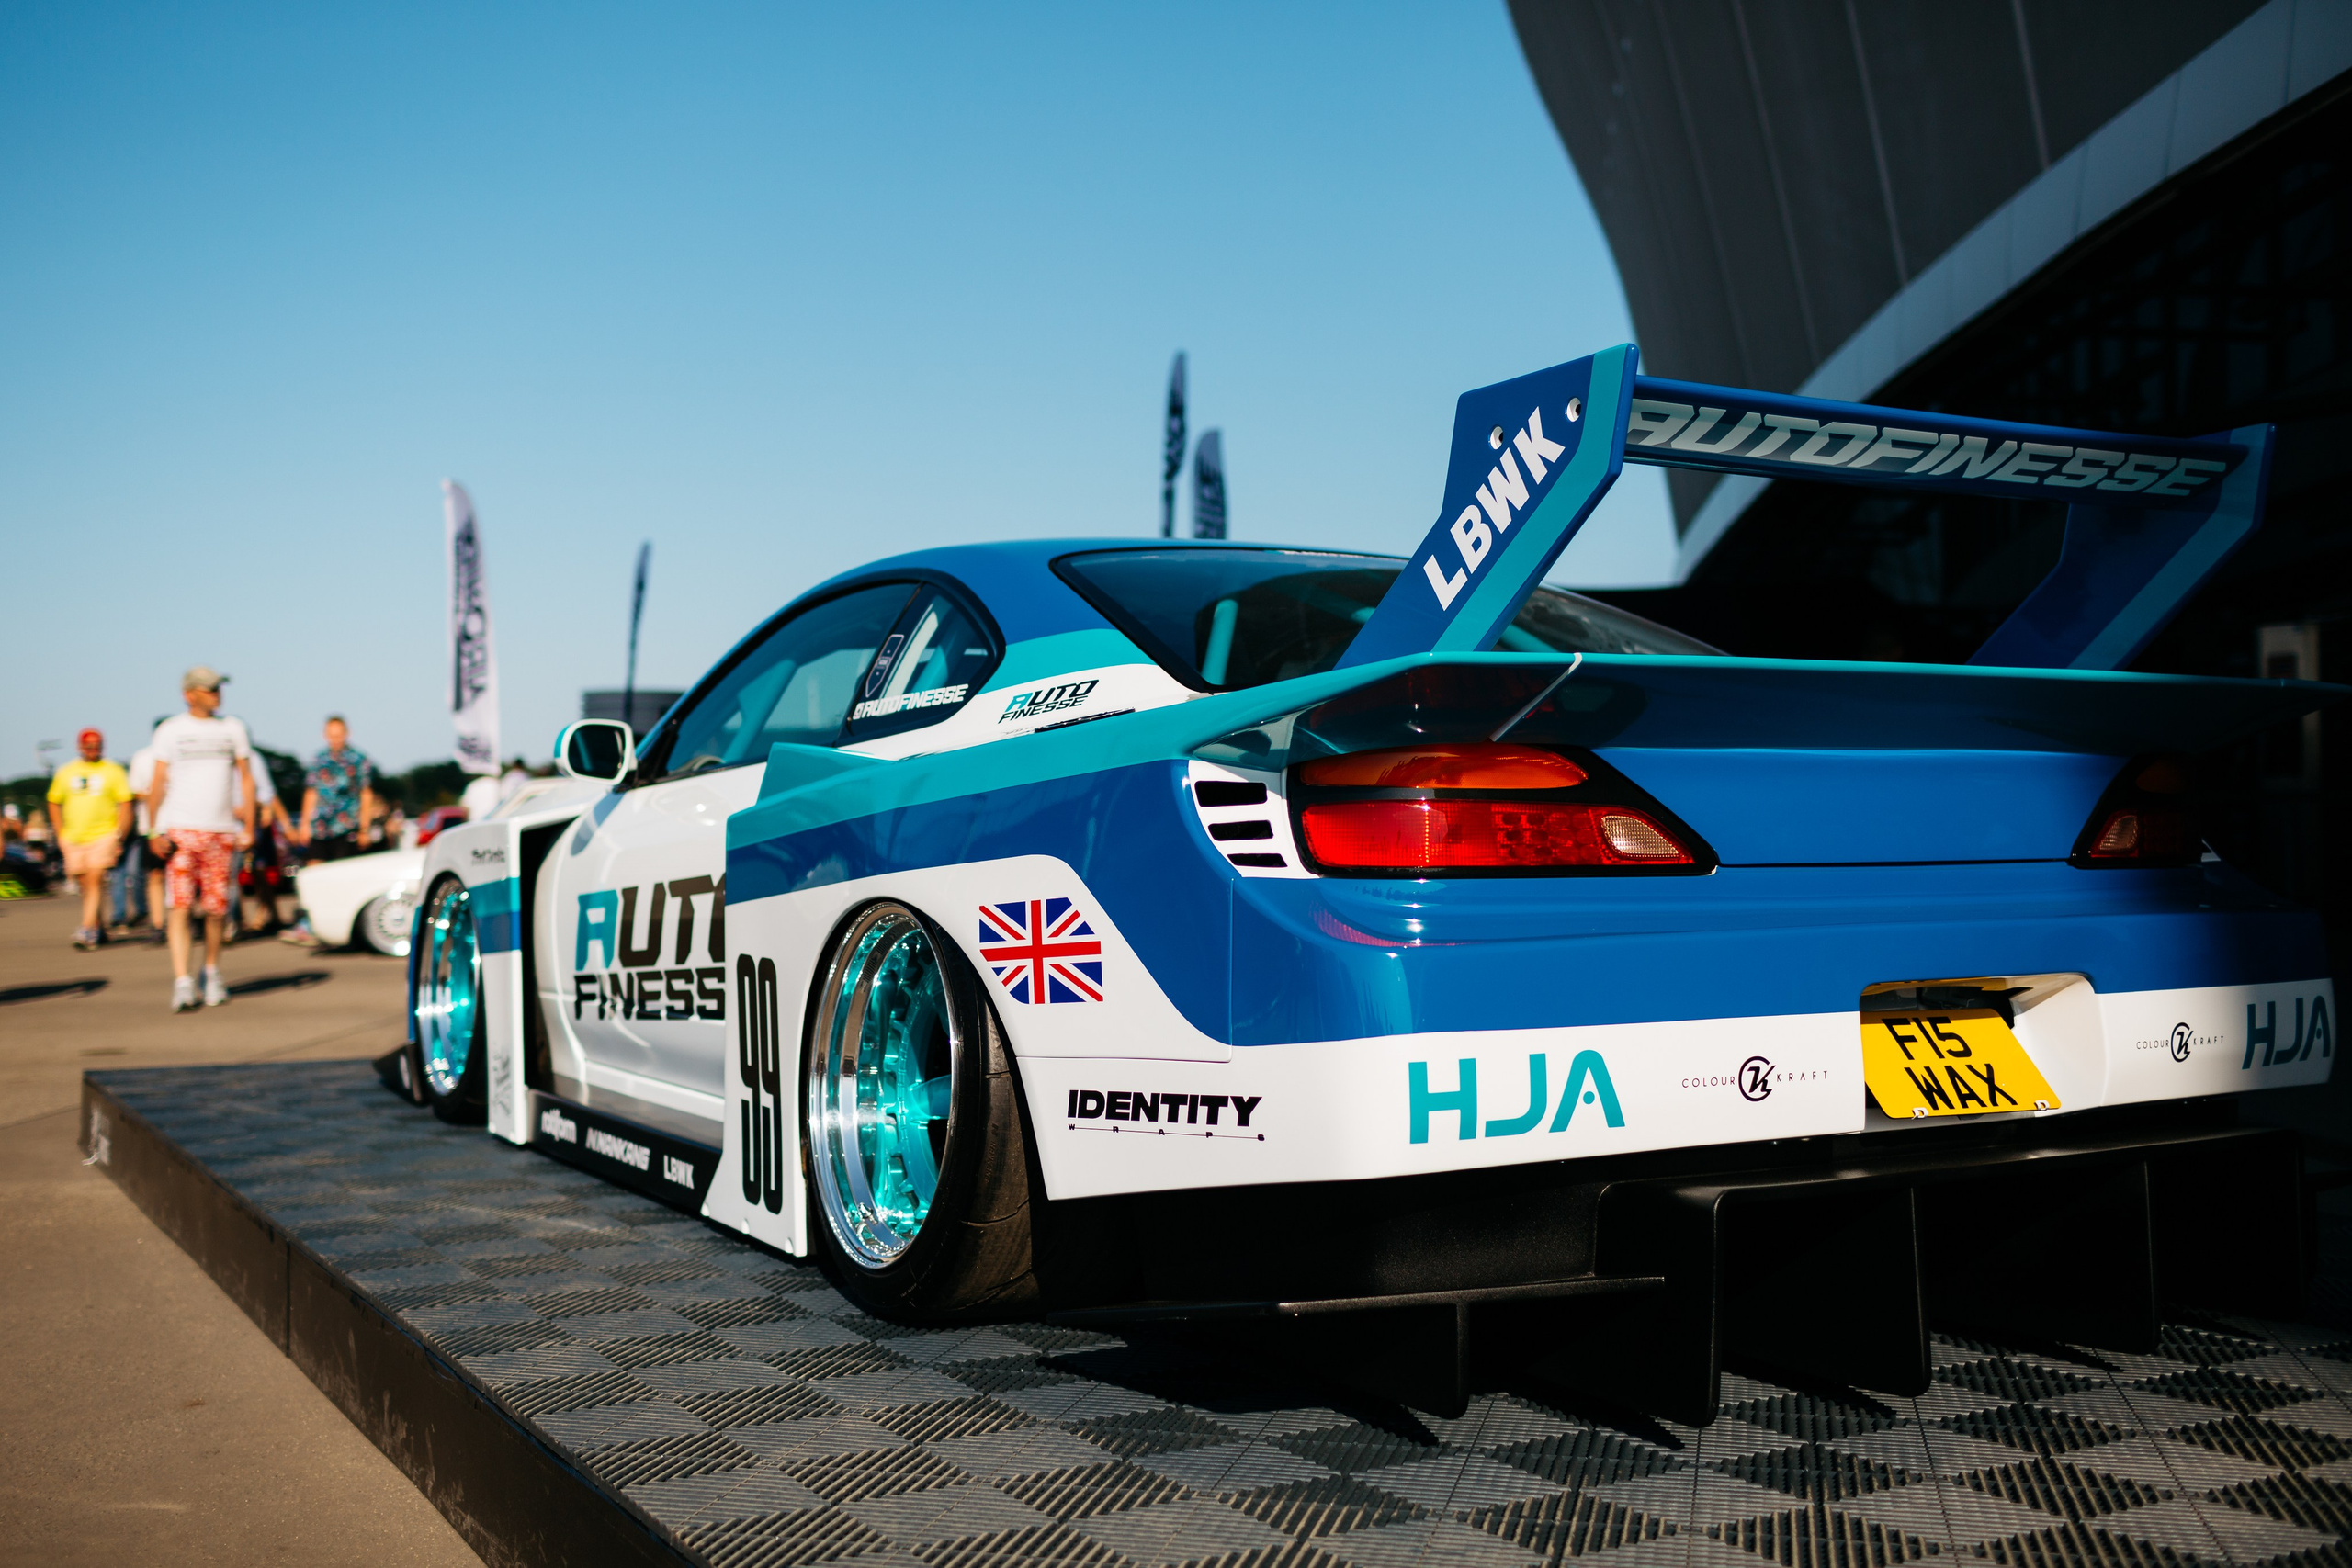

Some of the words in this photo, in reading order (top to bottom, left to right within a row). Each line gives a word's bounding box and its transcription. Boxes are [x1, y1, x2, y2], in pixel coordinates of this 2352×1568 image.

[1627, 398, 2227, 497] AUTOFINESSE
[1423, 406, 1566, 612] LBWK
[998, 695, 1089, 725] FINESSE
[1005, 679, 1100, 712] AUTO
[575, 872, 726, 972] AUT
[1882, 1015, 1973, 1061] F15
[2136, 1039, 2169, 1050] COLOUR
[2193, 1035, 2224, 1046] KRAFT
[2242, 995, 2332, 1070] HJA
[737, 953, 783, 1216] 99
[1408, 1049, 1626, 1145] HJA
[1681, 1076, 1736, 1089] COLOUR
[1776, 1070, 1828, 1082] KRAFT
[1904, 1063, 2018, 1111] WAX
[1067, 1089, 1263, 1128] IDENTITY
[663, 1154, 695, 1190] LBWK
